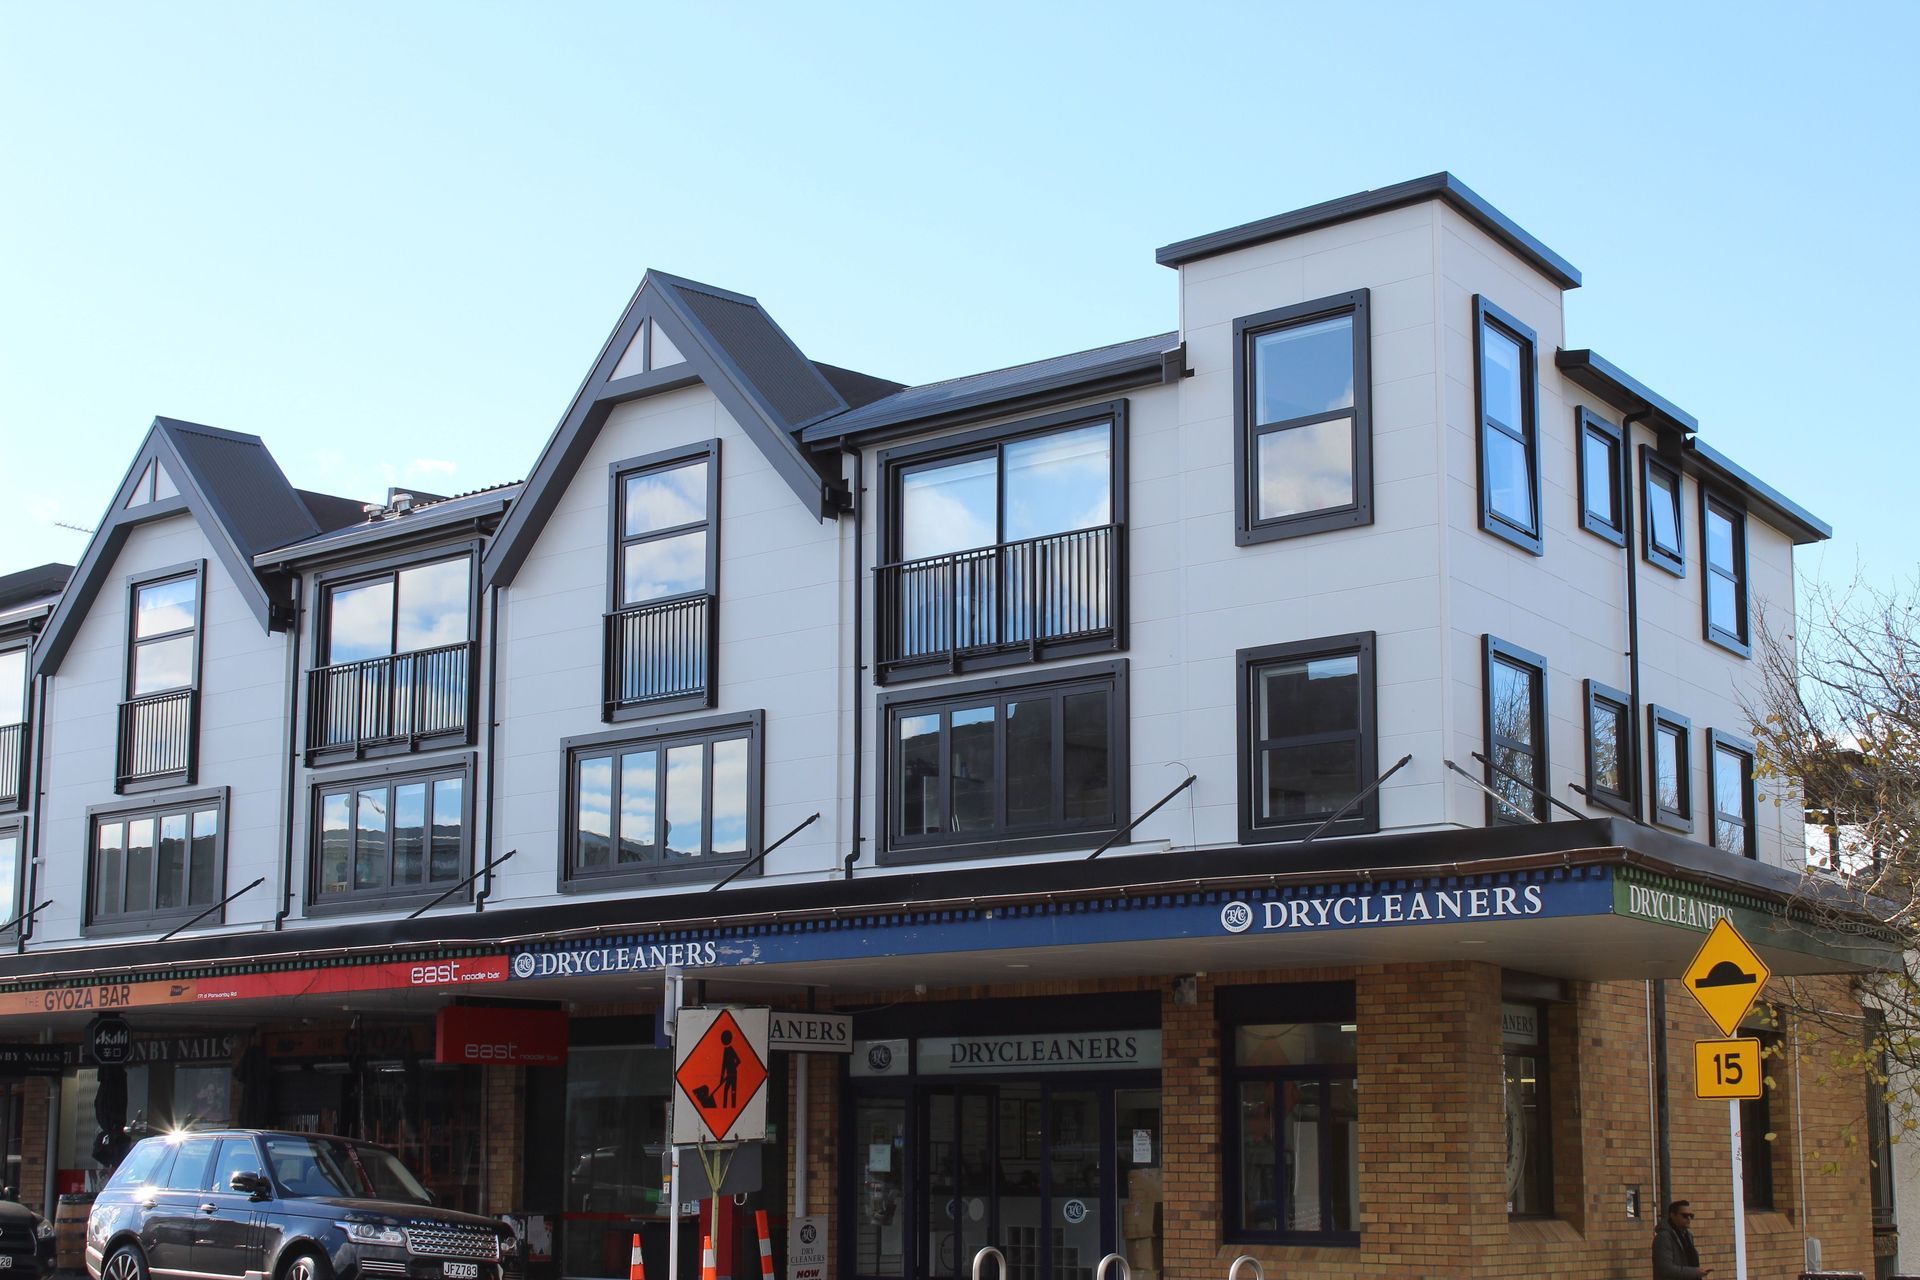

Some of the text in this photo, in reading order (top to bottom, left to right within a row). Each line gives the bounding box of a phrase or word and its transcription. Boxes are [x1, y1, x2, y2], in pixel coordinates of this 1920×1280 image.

[1263, 885, 1543, 929] DRYCLEANERS
[541, 941, 717, 975] DRYCLEANERS
[411, 961, 501, 983] east noodle bar
[24, 985, 131, 1010] THE GYOZA BAR
[769, 1019, 846, 1041] ANERS
[1502, 1014, 1534, 1033] ANERS
[95, 1029, 128, 1045] Asahi
[178, 1037, 232, 1059] NAILS
[465, 1042, 518, 1059] east
[950, 1037, 1137, 1063] DRYCLEANERS
[1713, 1053, 1743, 1085] 15
[411, 1220, 451, 1228] RANGE
[790, 1254, 825, 1263] CLEANERS
[801, 1247, 815, 1255] DRY
[444, 1263, 477, 1277] JFZ783
[796, 1269, 820, 1279] NOW
